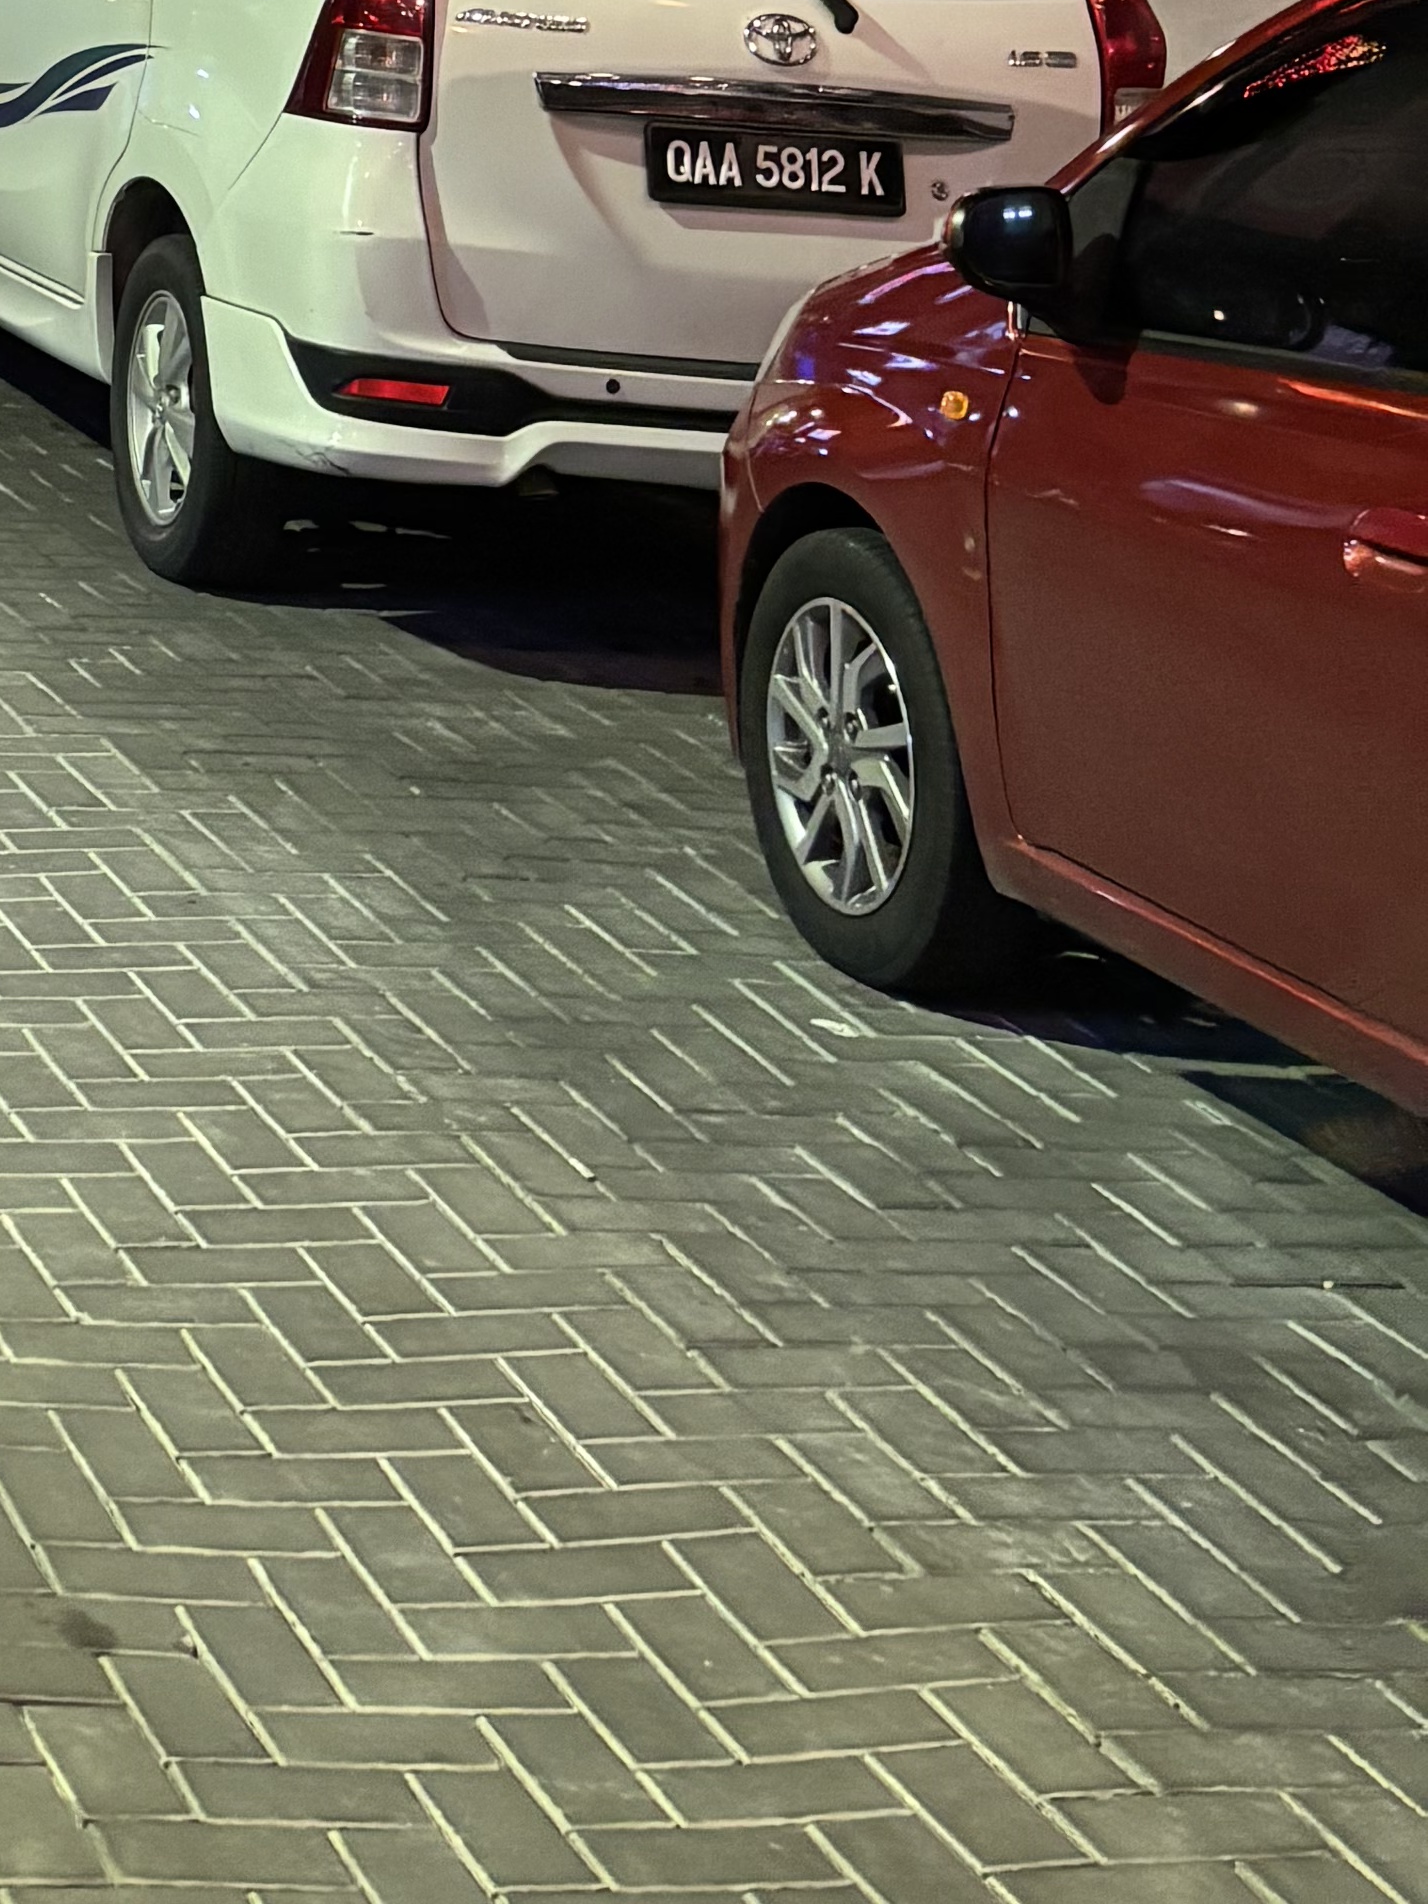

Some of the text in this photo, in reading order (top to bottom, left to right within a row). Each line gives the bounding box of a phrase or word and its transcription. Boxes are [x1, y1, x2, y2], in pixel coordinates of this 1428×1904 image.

[666, 139, 885, 196] QAA 5812 K
